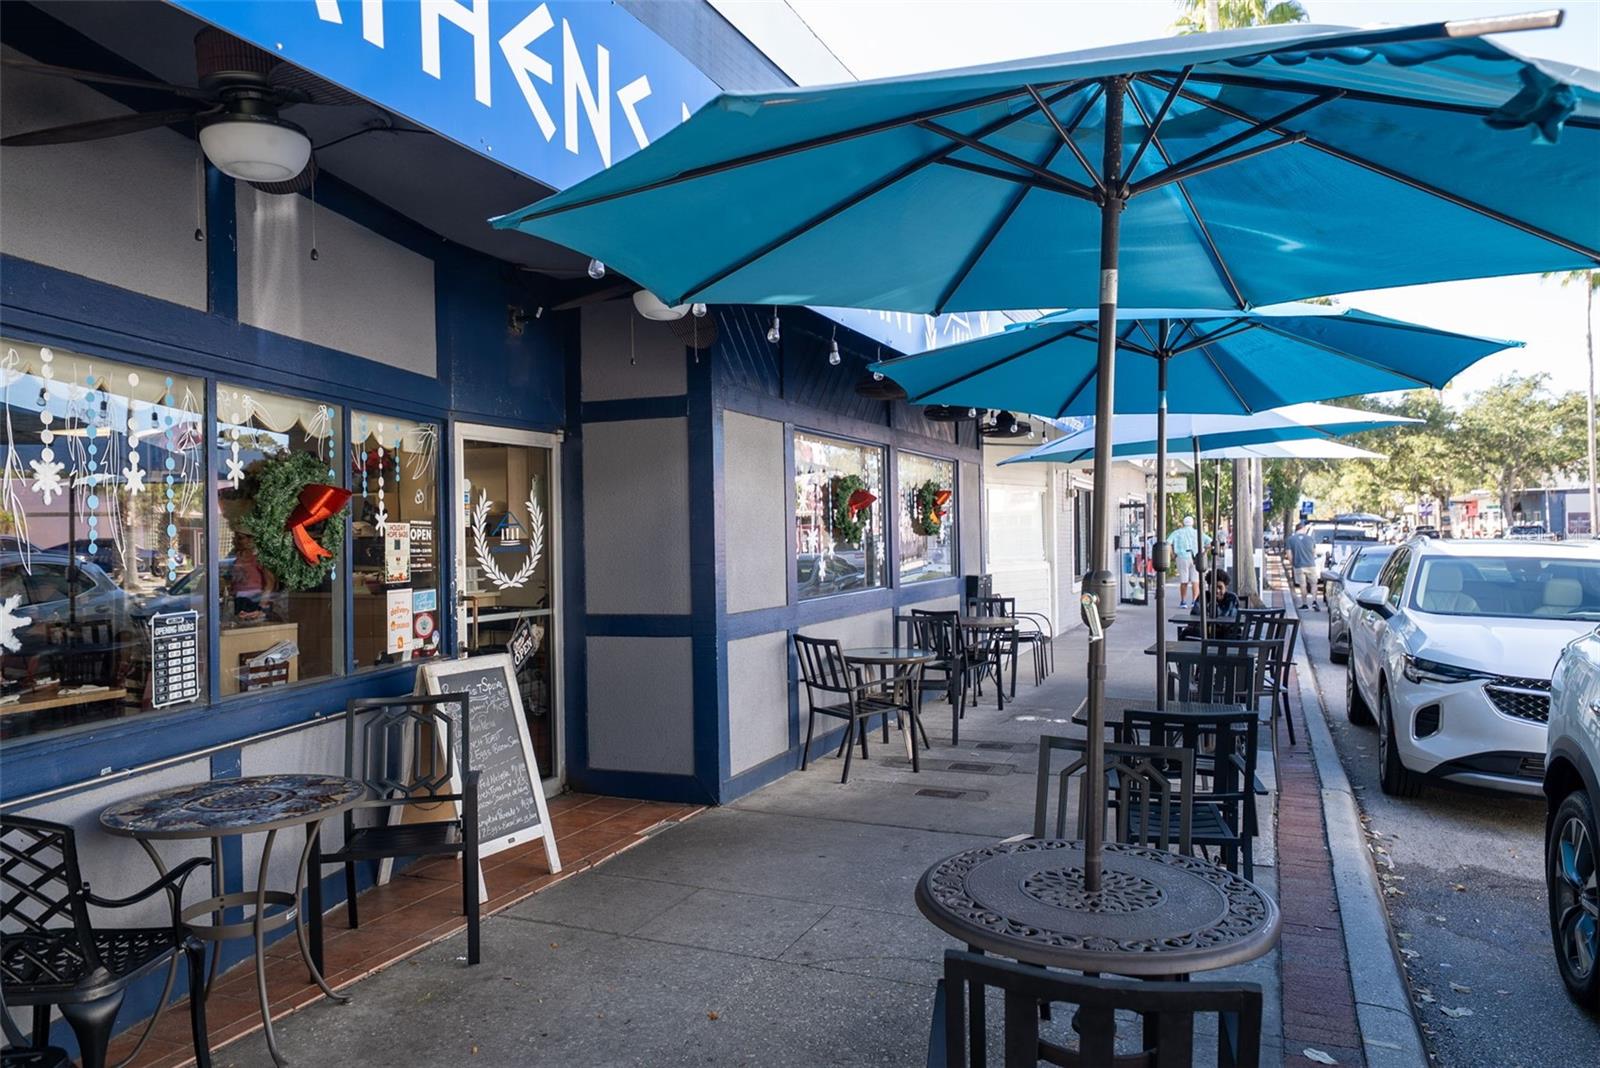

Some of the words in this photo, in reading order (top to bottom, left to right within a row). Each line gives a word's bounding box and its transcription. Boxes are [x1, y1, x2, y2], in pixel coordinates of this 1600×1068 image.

[410, 529, 432, 540] OPEN
[155, 625, 177, 635] OPENING
[178, 623, 194, 632] HOURS
[514, 636, 533, 665] OPEN
